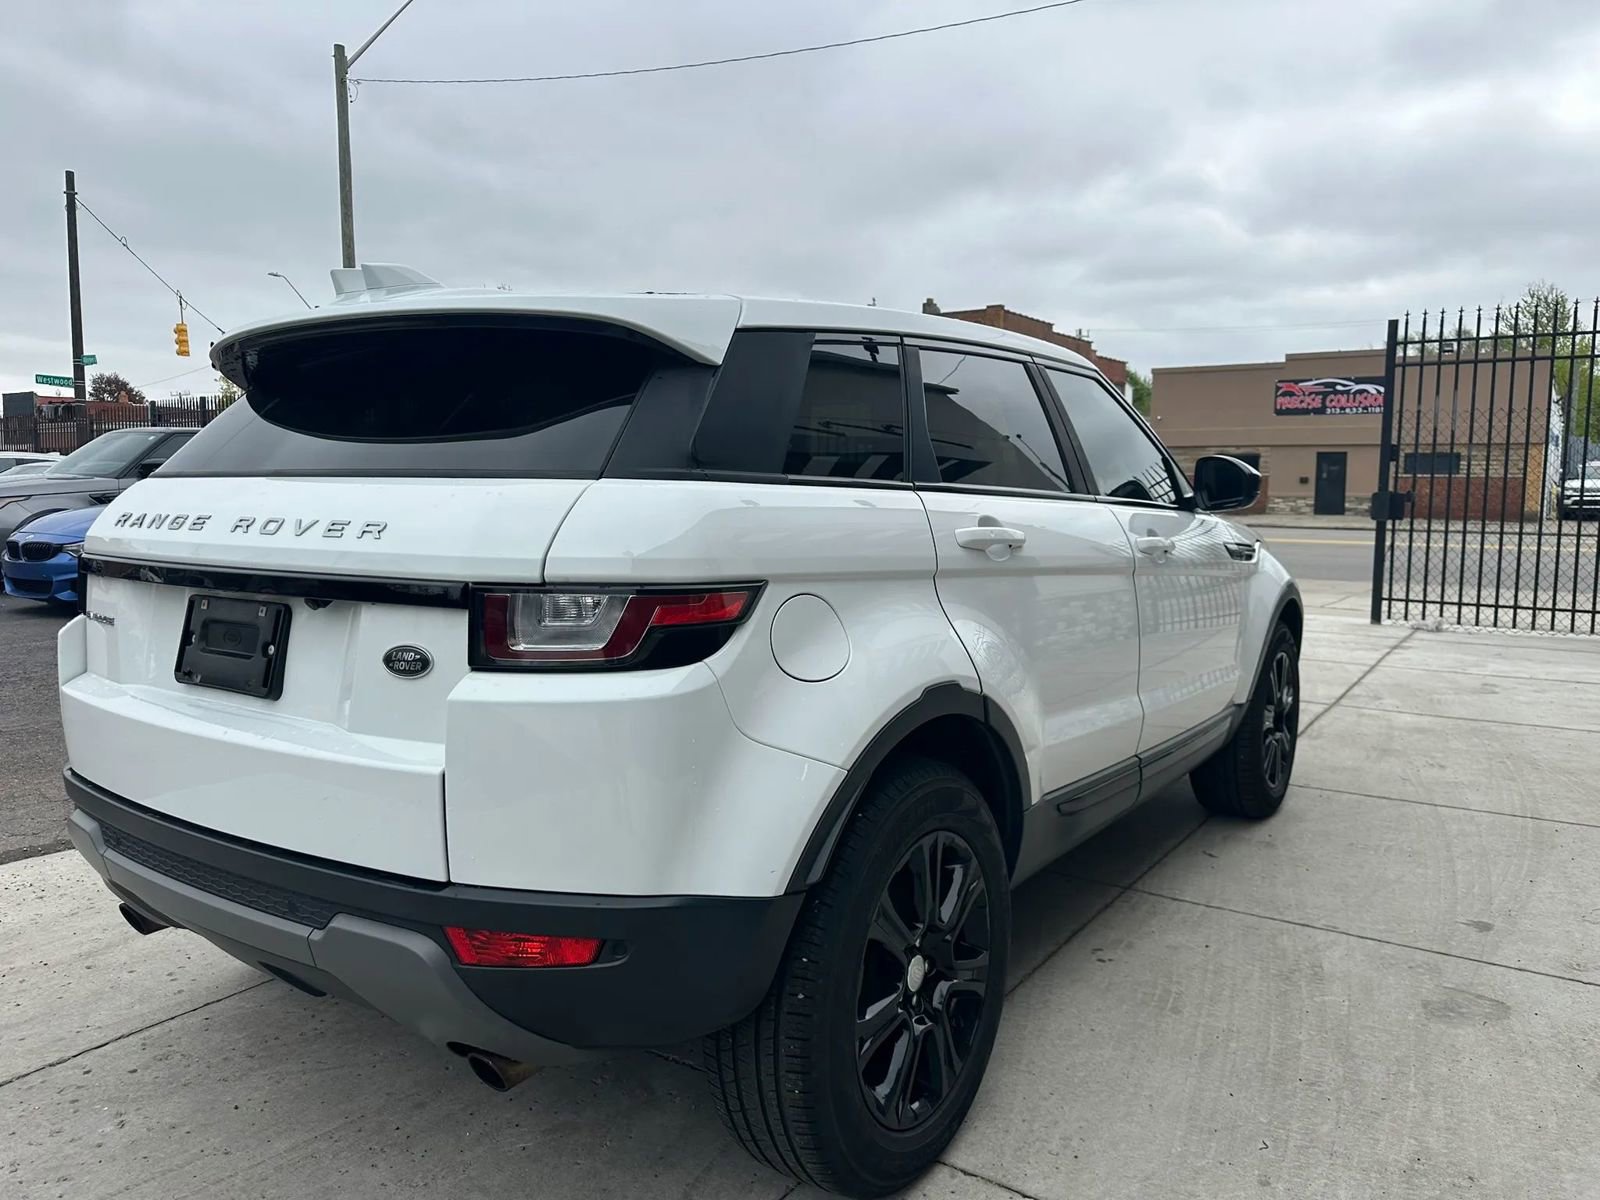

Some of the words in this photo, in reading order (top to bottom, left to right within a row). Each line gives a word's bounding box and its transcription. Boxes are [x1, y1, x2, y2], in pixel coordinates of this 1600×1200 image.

[36, 375, 73, 386] Westwood
[1276, 394, 1322, 409] PRECISE
[114, 511, 212, 532] RANGE
[230, 515, 388, 540] ROVER
[392, 652, 415, 660] LAND
[393, 660, 422, 670] ROVER
